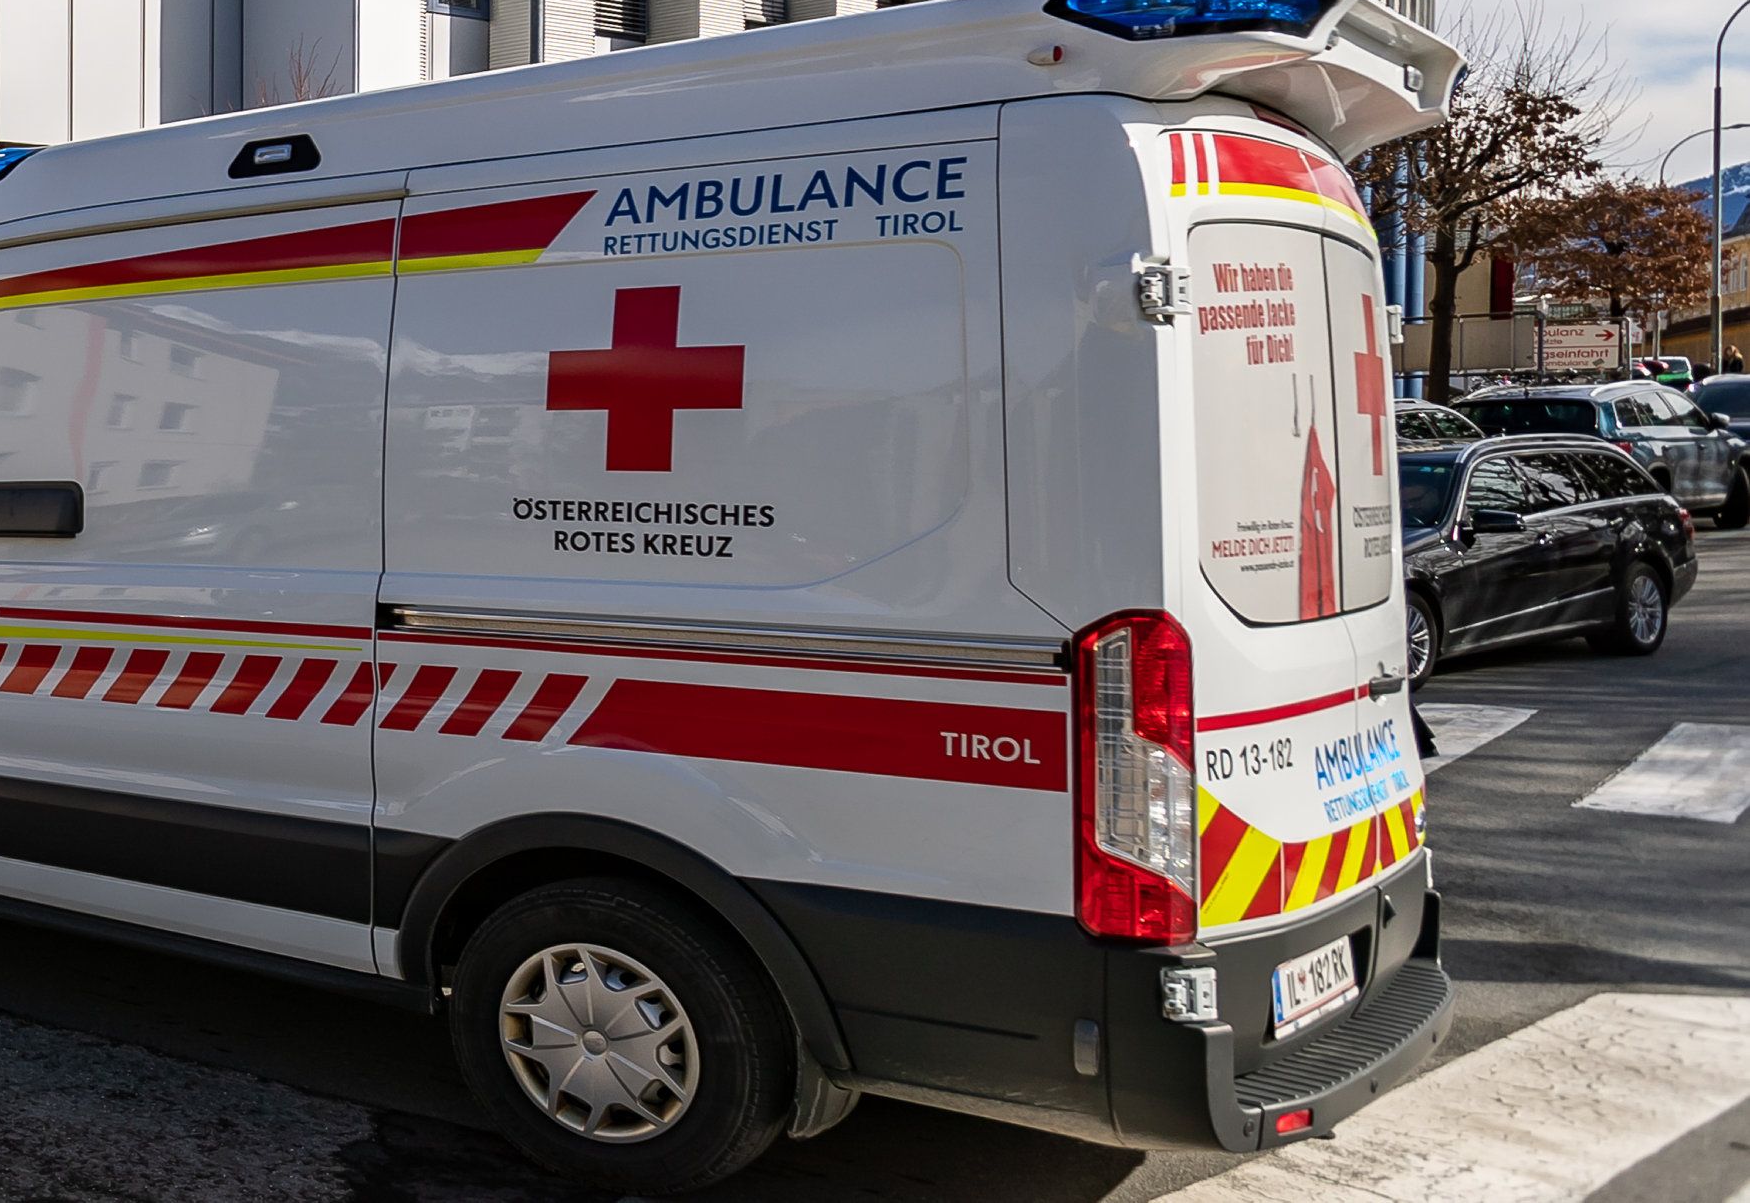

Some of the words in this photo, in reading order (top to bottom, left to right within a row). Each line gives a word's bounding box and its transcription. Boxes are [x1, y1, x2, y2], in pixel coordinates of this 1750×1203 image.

[604, 156, 968, 227] AMBULANCE
[603, 218, 839, 256] RETTUNGSDIENST
[875, 210, 964, 237] TIROL
[1212, 262, 1239, 293] Wir
[1239, 262, 1278, 292] haben
[1277, 262, 1294, 291] die
[1197, 298, 1265, 335] passende
[1265, 297, 1296, 327] Jacke
[1246, 334, 1264, 365] für
[1266, 332, 1295, 363] Dich!
[1543, 348, 1609, 362] gseinfahrt
[512, 496, 775, 528] ÖSTERREICHISCHES
[553, 530, 636, 554] ROTES
[643, 533, 734, 558] KREUZ
[1211, 539, 1247, 559] MELDE
[1249, 537, 1270, 556] DICH
[939, 731, 1041, 765] TIROL
[1206, 748, 1234, 782] RD
[1238, 737, 1294, 776] 13-182
[1314, 718, 1401, 791] AMBULANCE
[1286, 970, 1302, 1010] IL
[1308, 953, 1333, 997] 182
[1332, 944, 1350, 985] RK
